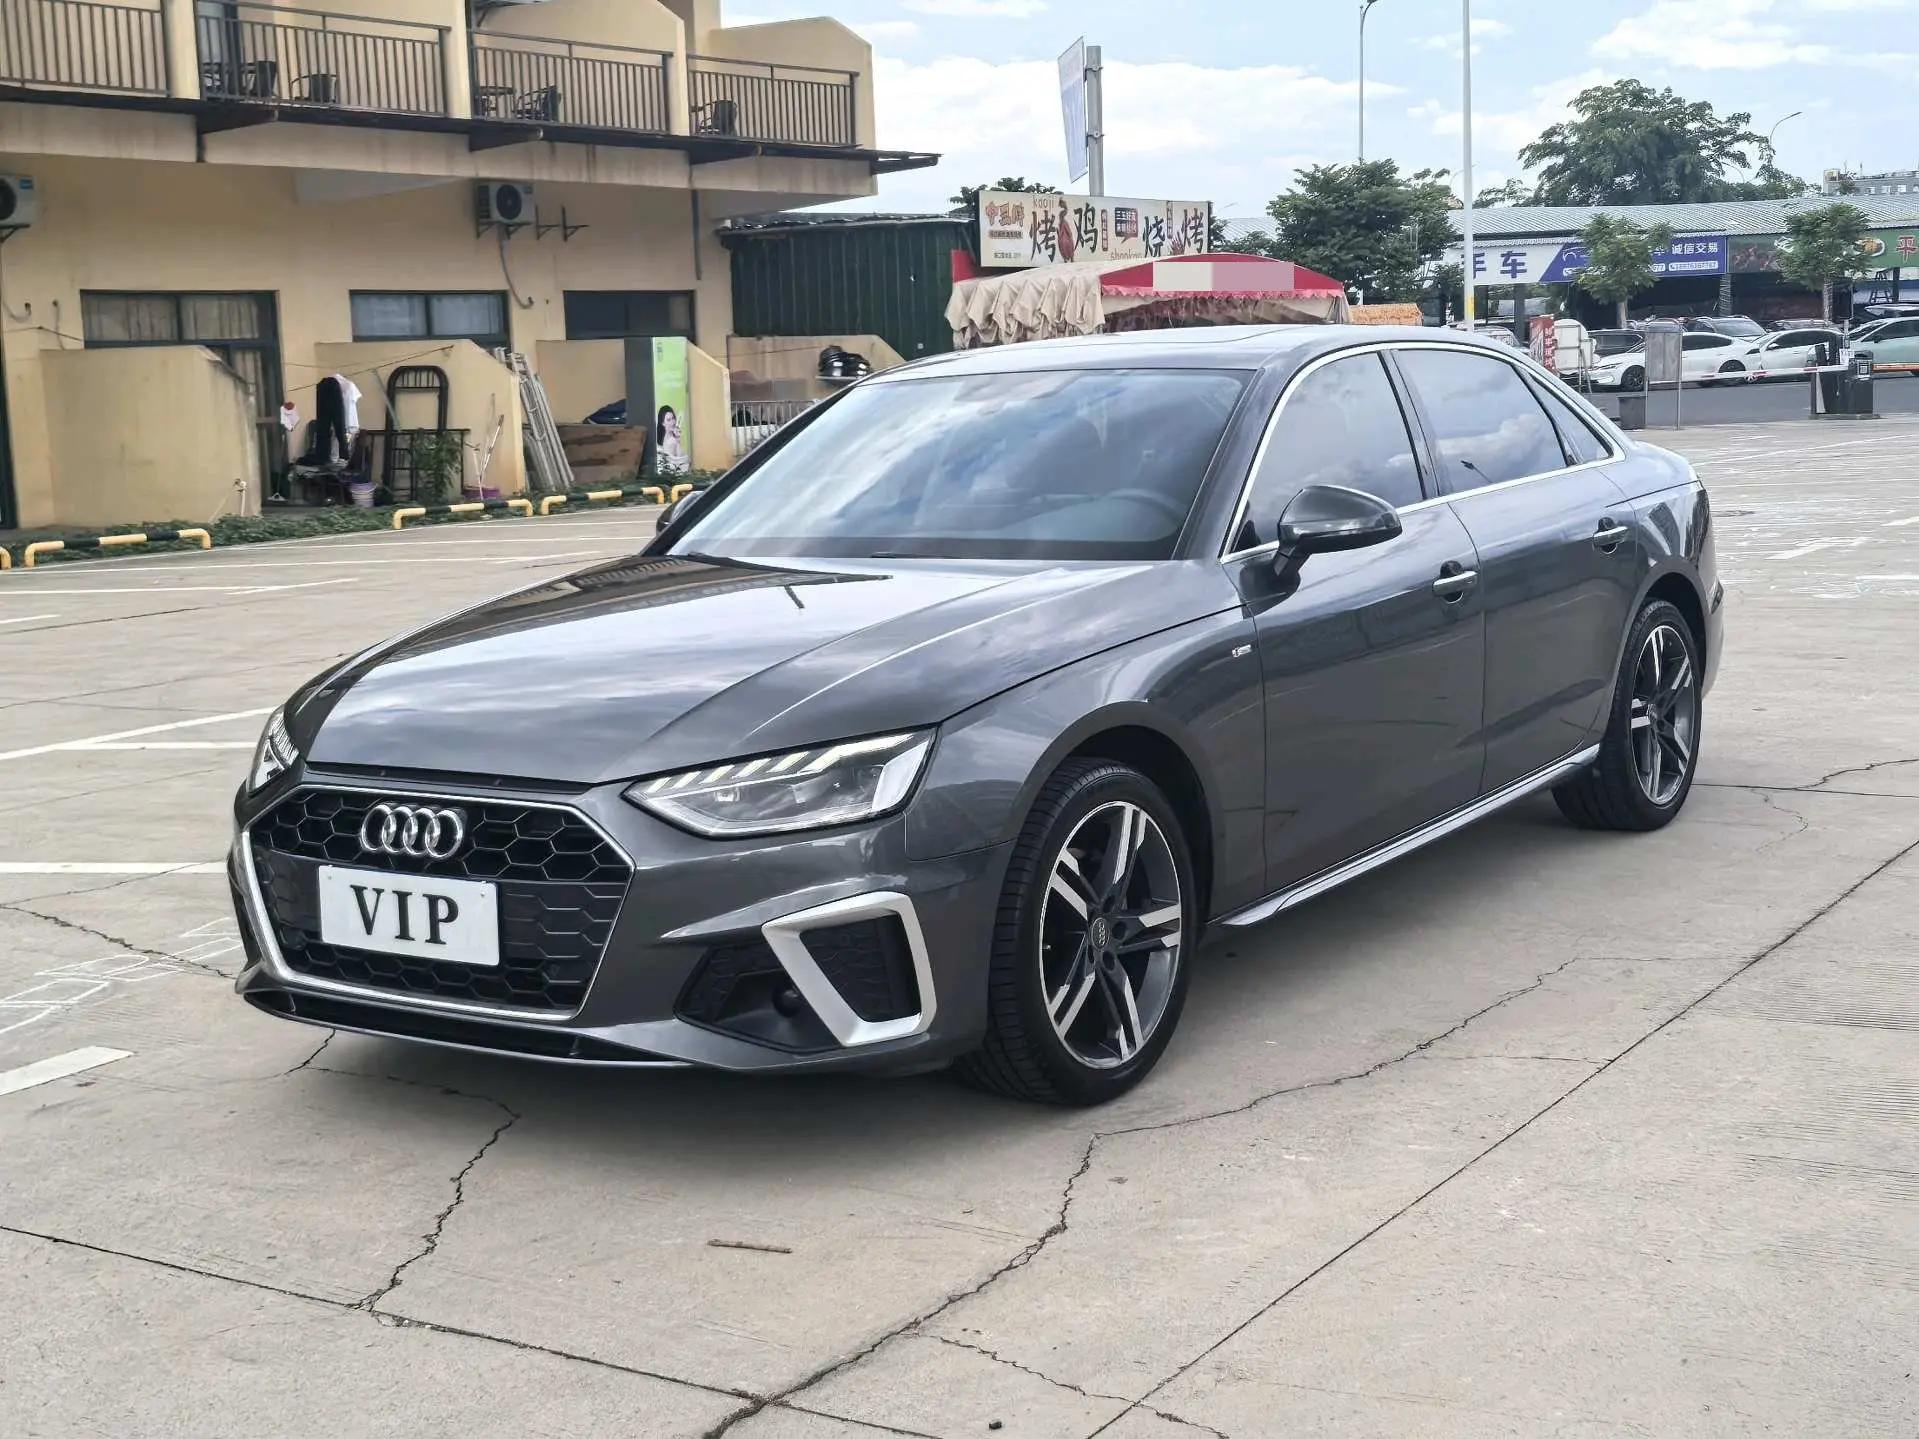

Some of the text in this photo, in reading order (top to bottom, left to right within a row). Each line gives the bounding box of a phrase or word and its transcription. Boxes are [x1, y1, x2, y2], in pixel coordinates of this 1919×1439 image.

[1671, 241, 1719, 255] 诚信交易
[350, 884, 459, 945] VIP
